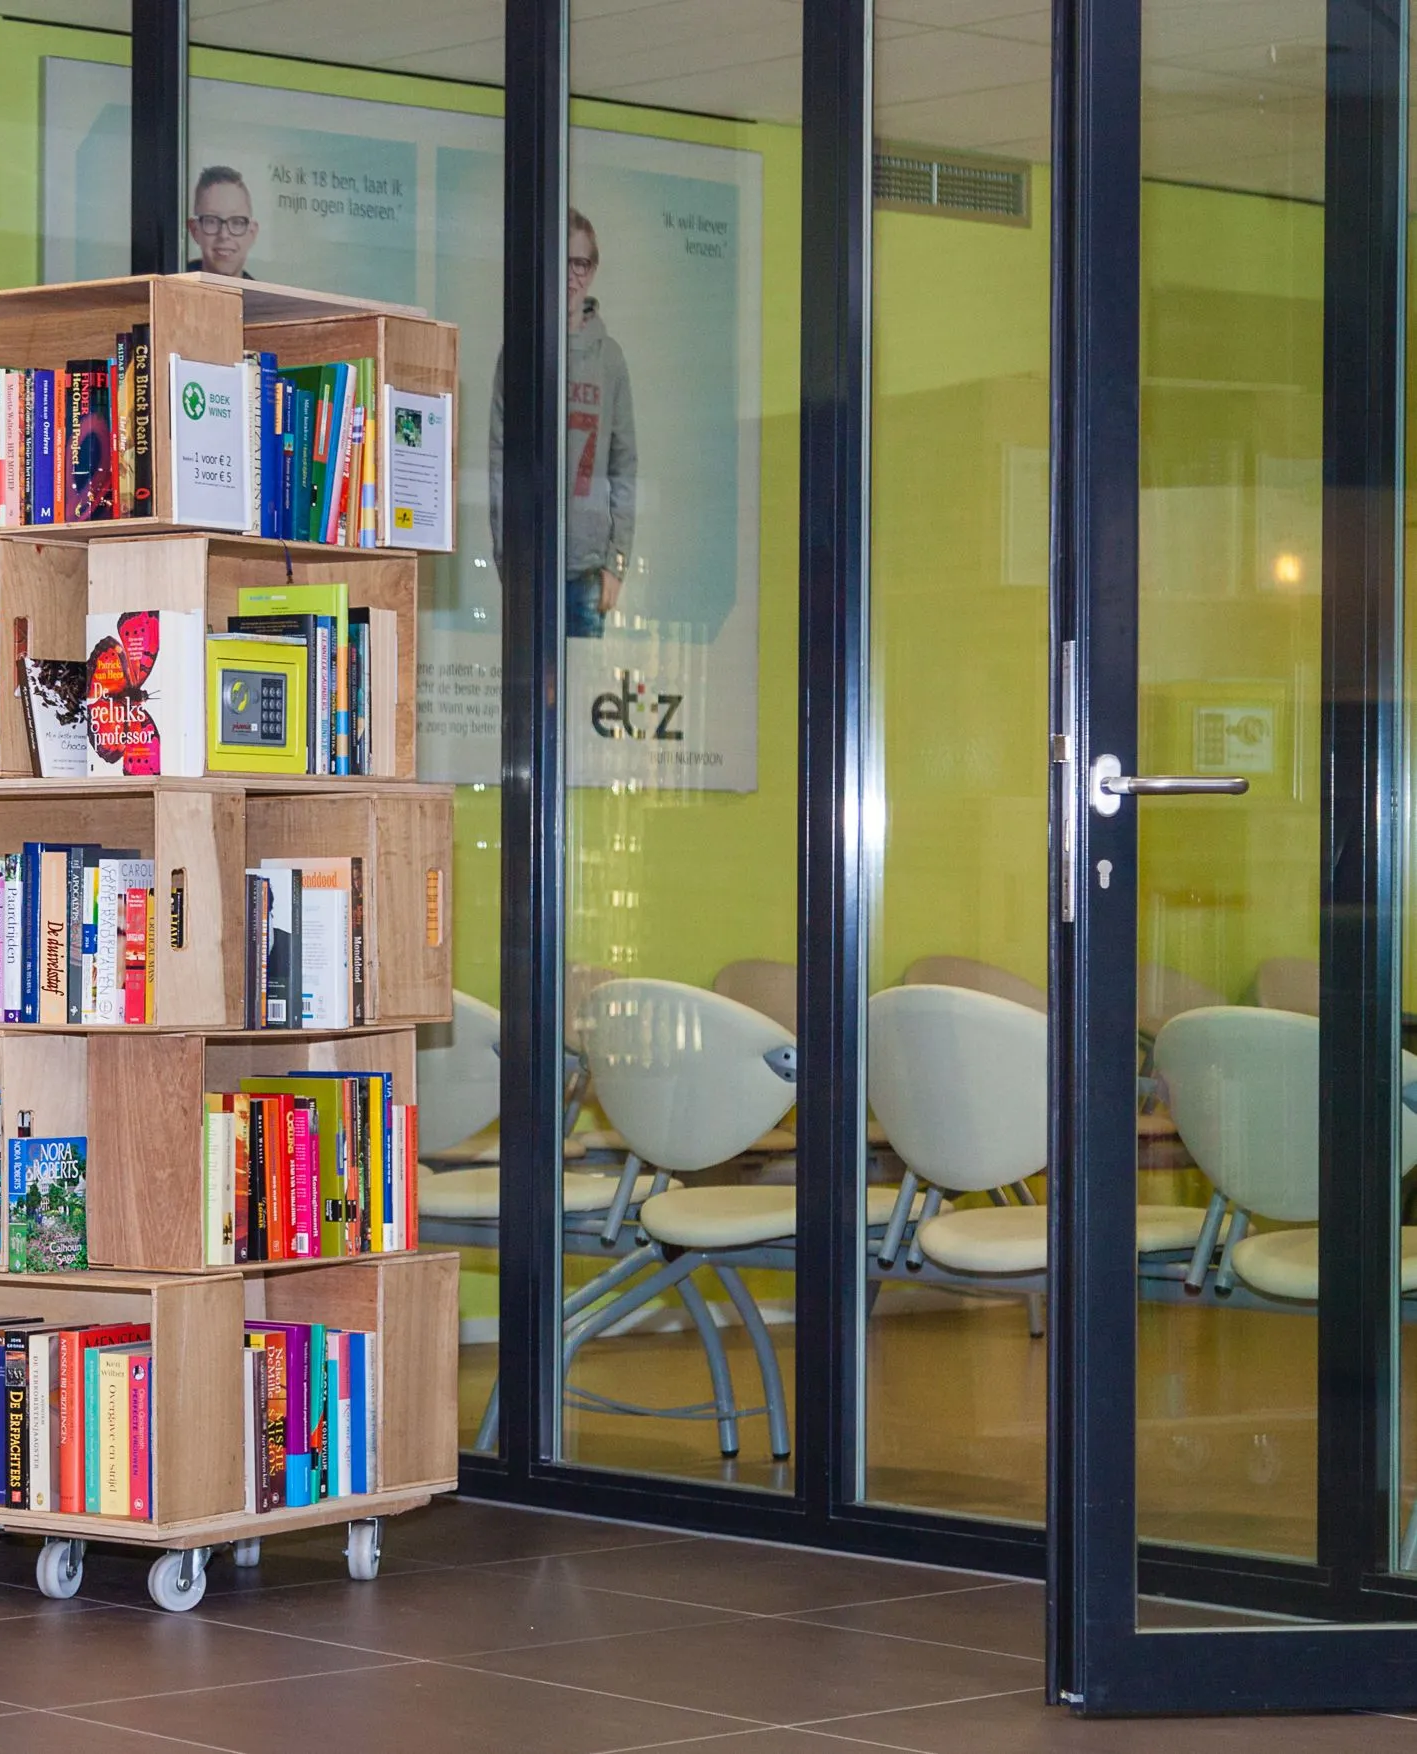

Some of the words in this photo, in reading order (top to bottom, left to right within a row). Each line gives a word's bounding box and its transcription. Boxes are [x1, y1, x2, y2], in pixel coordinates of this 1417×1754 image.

[296, 166, 307, 185] ik
[312, 170, 328, 188] 18
[364, 173, 388, 195] laat
[392, 178, 403, 197] ik
[278, 193, 307, 214] mijn
[312, 197, 344, 217] ogen
[136, 344, 149, 369] The
[73, 372, 81, 391] Het
[81, 373, 89, 415] FINDER
[136, 376, 149, 413] Black
[72, 392, 81, 427] Orakel
[208, 406, 232, 419] WINST
[209, 393, 231, 405] BOEK
[70, 428, 80, 465] Project
[136, 416, 149, 456] Death
[194, 452, 199, 463] 1
[201, 455, 218, 465] voor
[219, 455, 225, 466] €
[226, 455, 232, 467] 2
[194, 468, 200, 479] 3
[201, 470, 218, 481] voor
[219, 471, 225, 482] €
[226, 471, 232, 483] 5
[97, 660, 121, 670] Patrick
[93, 682, 110, 700] De
[90, 696, 146, 733] geluks
[93, 725, 155, 752] professor
[72, 874, 80, 921] APOCALYPS
[6, 887, 19, 964] Paardrijden
[46, 920, 64, 937] De
[41, 939, 64, 997] duivelsstaf
[354, 936, 362, 984] Monddood
[286, 1110, 295, 1155] COLLINS
[40, 1142, 72, 1162] NORA
[14, 1162, 22, 1190] ROBERTS
[34, 1159, 79, 1181] ROBERTS
[49, 1242, 82, 1254] Calhoun
[55, 1253, 77, 1266] Saga
[267, 1345, 277, 1399] DeMille
[275, 1348, 284, 1394] Nelson
[9, 1390, 24, 1409] DE
[108, 1384, 117, 1442] Overgave
[9, 1413, 24, 1488] ERFPACHTERS
[108, 1445, 115, 1460] en
[267, 1408, 276, 1477] SAIGON
[275, 1412, 284, 1472] MISSIE
[108, 1463, 117, 1493] strijd
